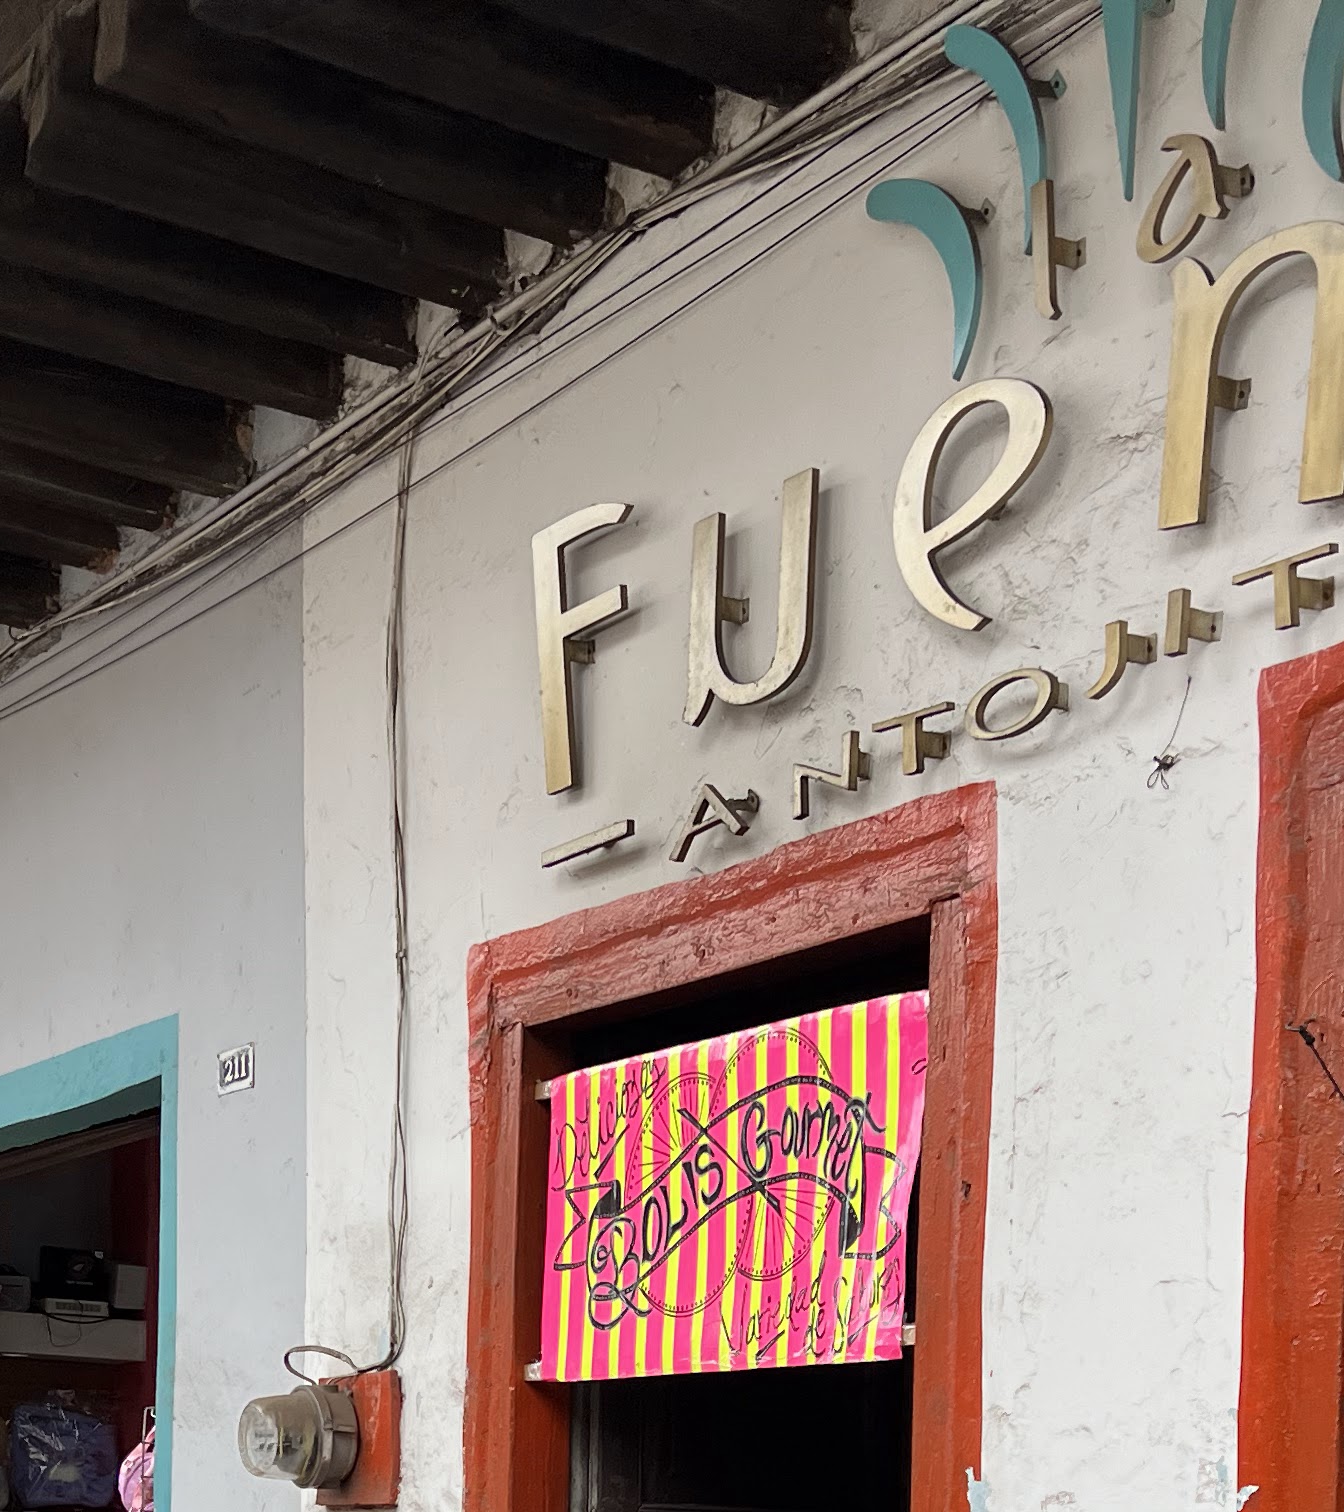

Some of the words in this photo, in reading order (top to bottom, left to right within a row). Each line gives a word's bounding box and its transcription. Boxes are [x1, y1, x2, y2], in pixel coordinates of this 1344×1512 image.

[1031, 134, 1230, 320] la
[588, 1146, 724, 1322] BOLIS
[740, 1094, 885, 1200] Gourmet
